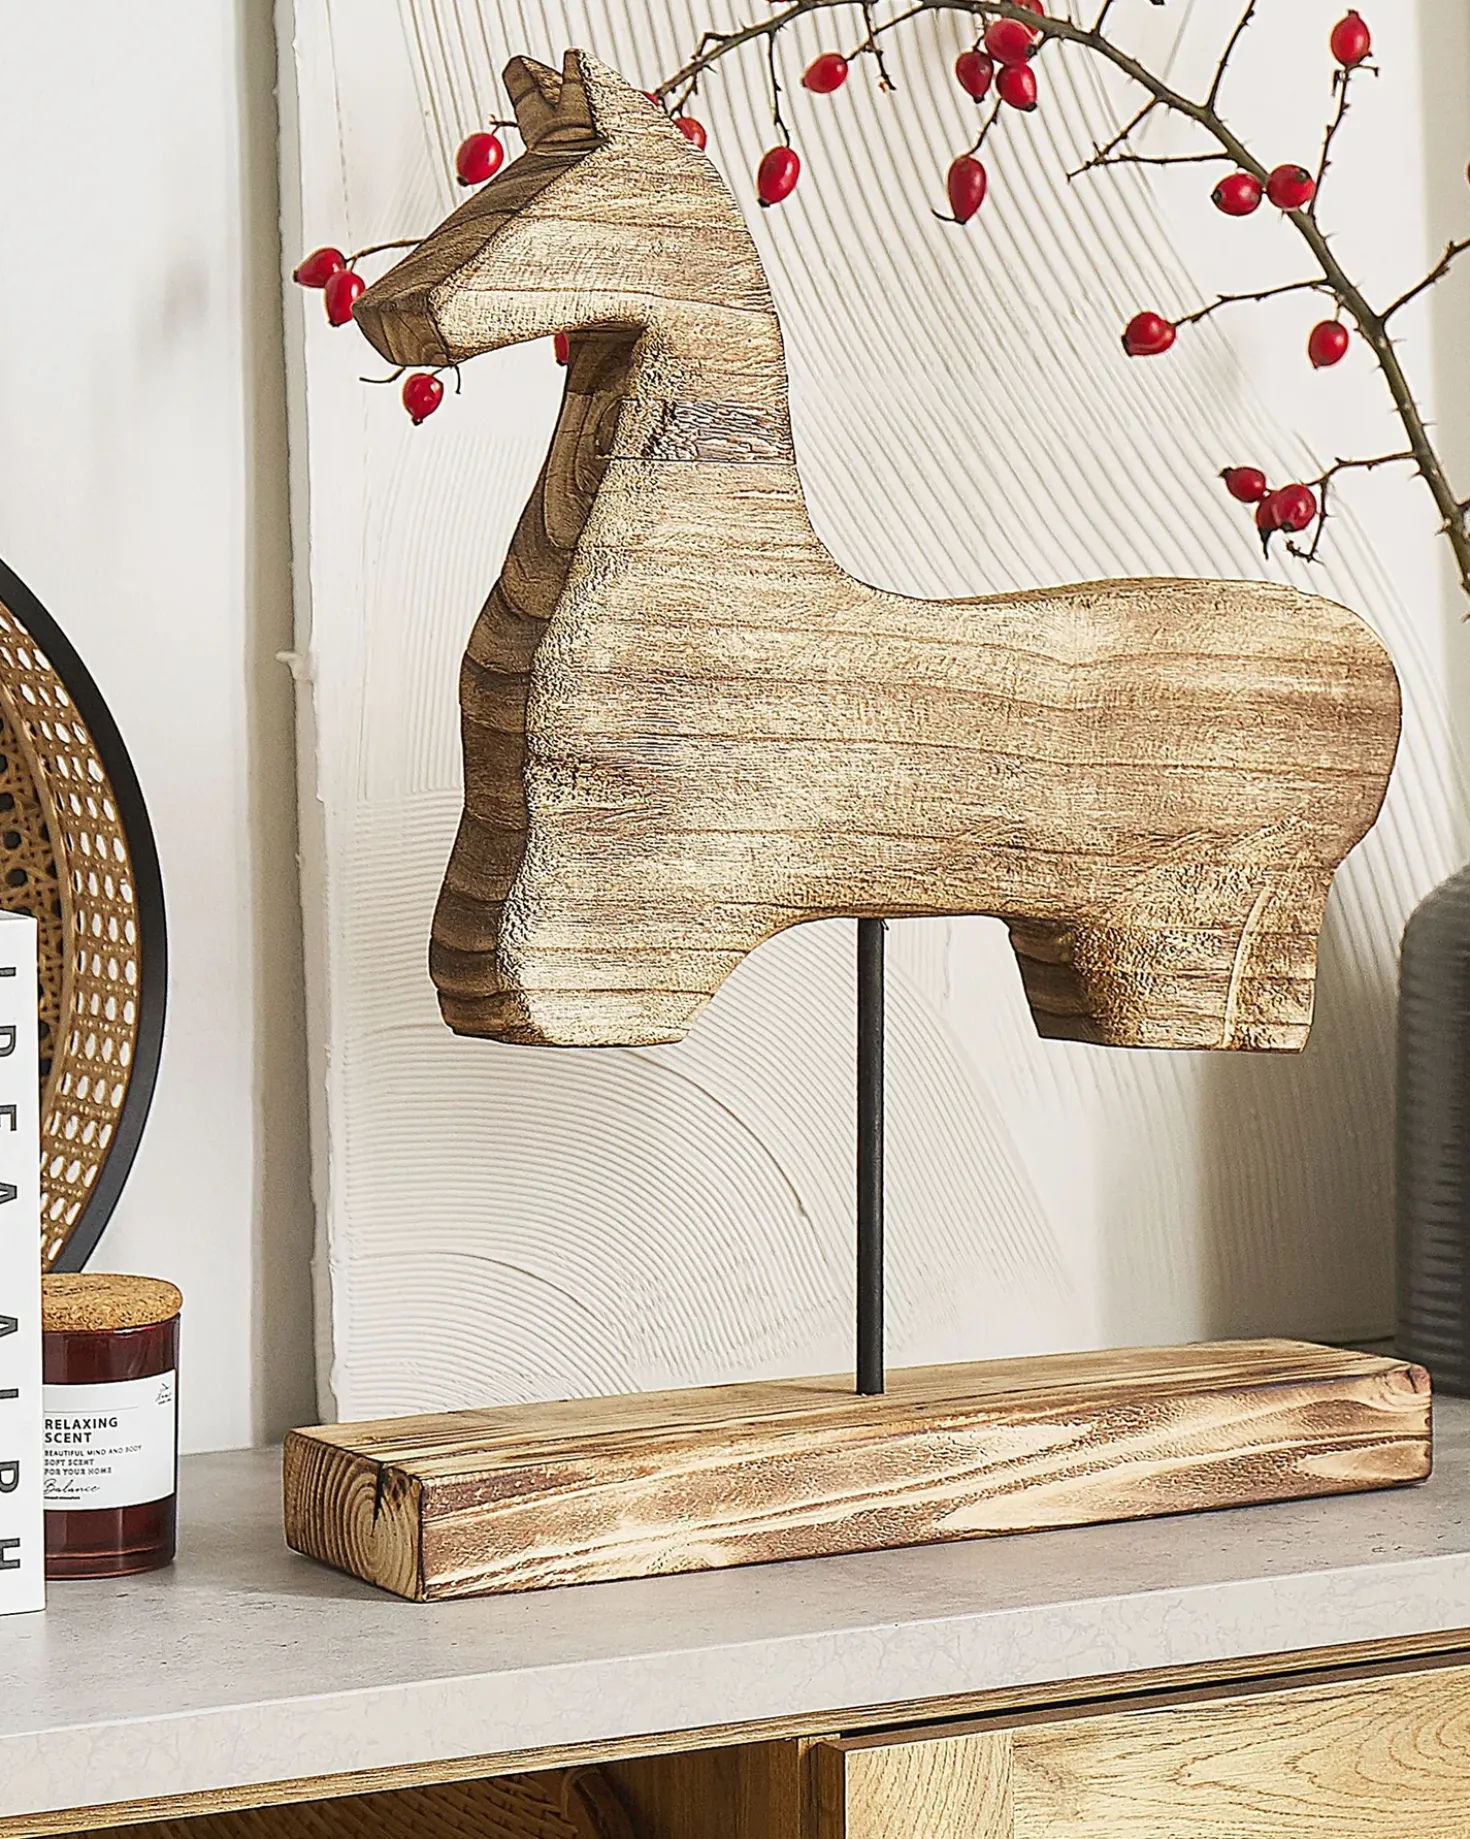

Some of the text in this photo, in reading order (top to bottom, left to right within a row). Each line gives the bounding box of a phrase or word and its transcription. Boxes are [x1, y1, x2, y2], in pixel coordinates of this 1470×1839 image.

[44, 1417, 118, 1430] RELAXING
[44, 1432, 92, 1443] SCENT
[44, 1449, 85, 1457] BEAUTIFUL
[108, 1447, 124, 1455] AND
[125, 1445, 142, 1453] BODY
[44, 1459, 65, 1467] SOFT
[88, 1467, 112, 1475] HOME
[43, 1478, 100, 1495] Balance
